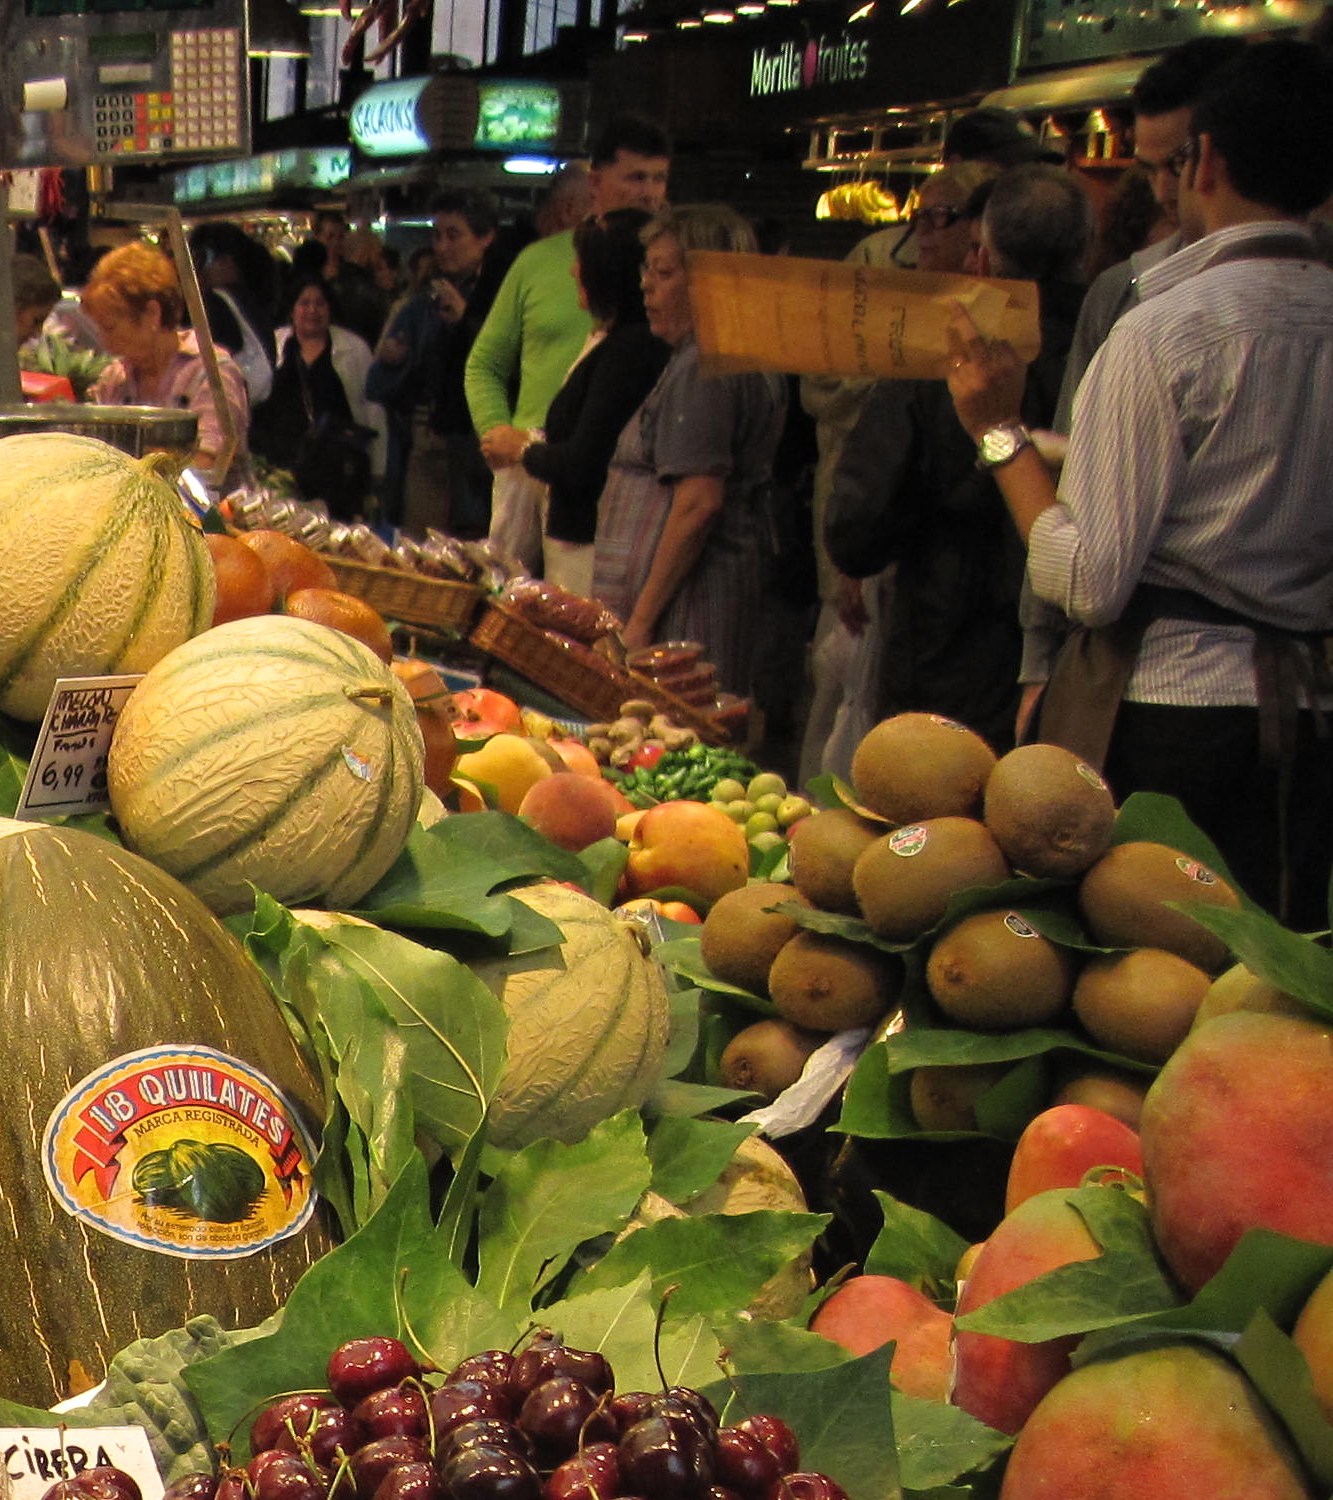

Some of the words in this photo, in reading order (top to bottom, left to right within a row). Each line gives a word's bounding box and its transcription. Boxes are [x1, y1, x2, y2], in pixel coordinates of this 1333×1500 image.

[750, 41, 802, 96] Morilla
[818, 31, 868, 83] fruites
[41, 761, 84, 791] 6,99
[132, 1111, 182, 1139] MARCA
[184, 1110, 261, 1147] REGISTRADA
[137, 1068, 285, 1145] QUILATES
